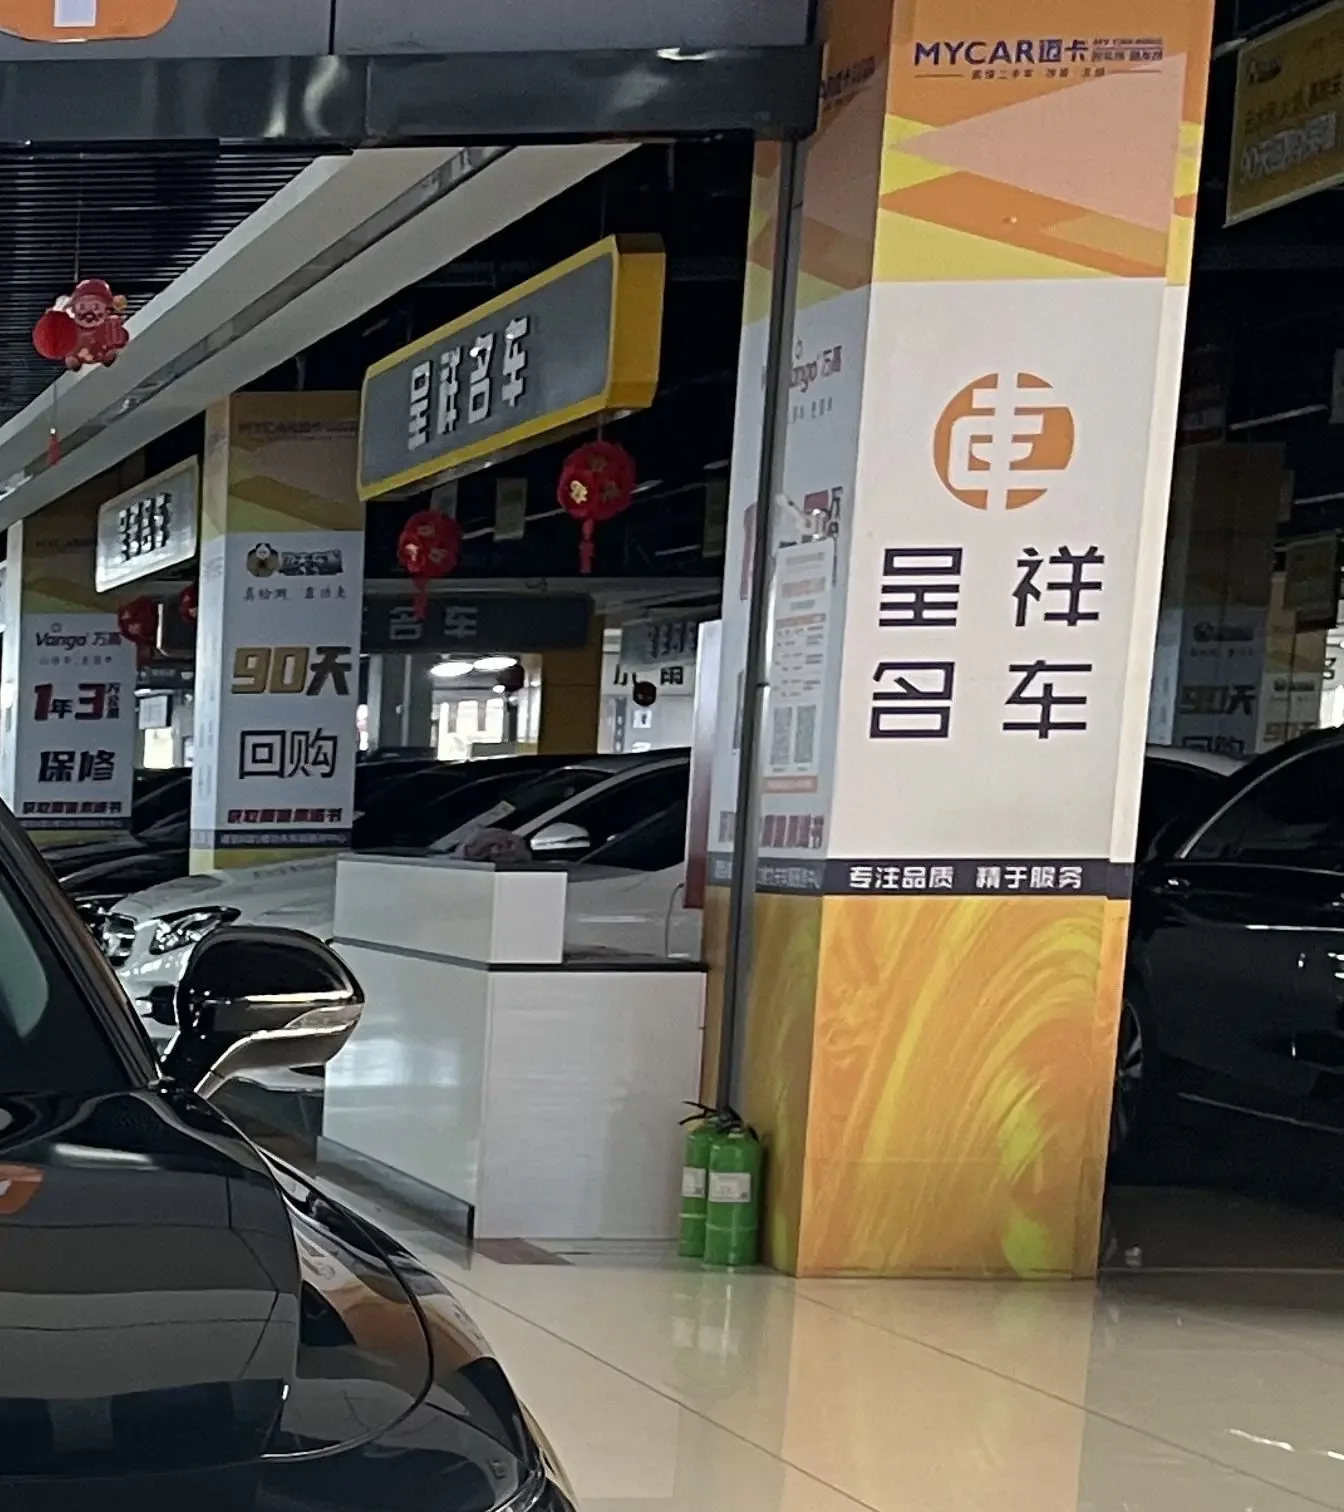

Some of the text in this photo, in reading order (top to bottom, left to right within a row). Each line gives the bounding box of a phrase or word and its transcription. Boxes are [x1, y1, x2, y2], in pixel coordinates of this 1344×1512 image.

[408, 316, 528, 451] 呈祥名车
[879, 545, 1106, 627] 呈祥
[231, 646, 352, 696] 90天
[869, 660, 1093, 740] 名车
[38, 750, 115, 783] 保修
[238, 728, 338, 780] 回购
[849, 866, 1083, 889] 专注品质 精于服务
